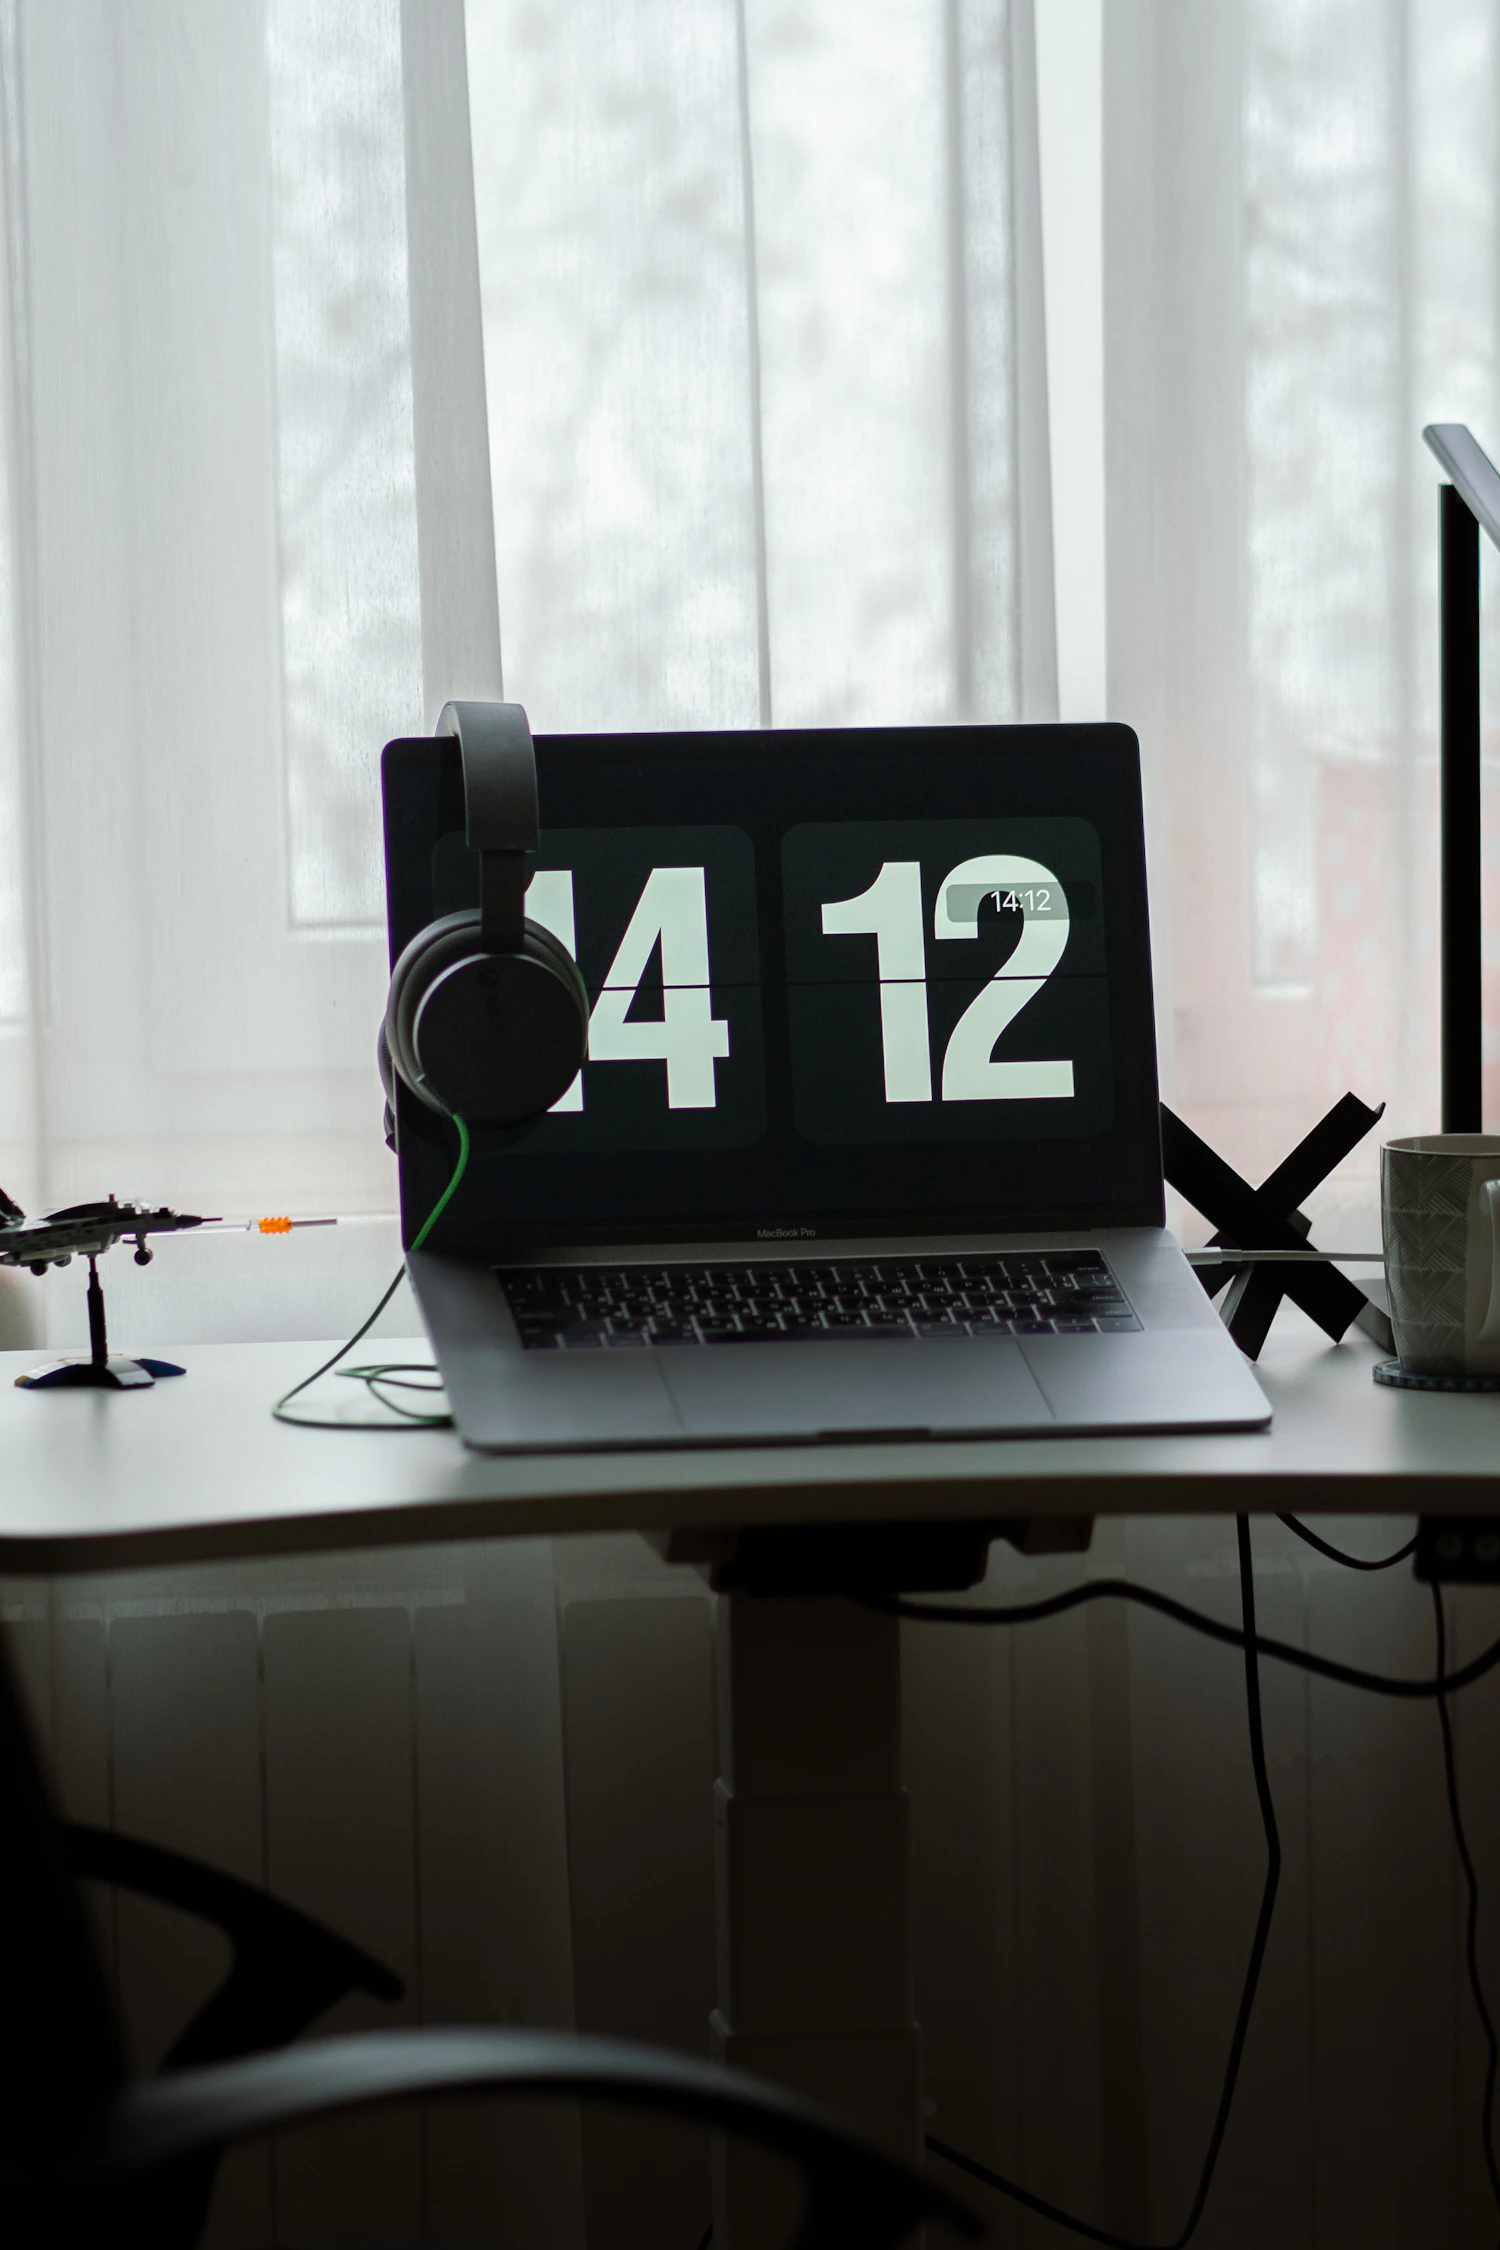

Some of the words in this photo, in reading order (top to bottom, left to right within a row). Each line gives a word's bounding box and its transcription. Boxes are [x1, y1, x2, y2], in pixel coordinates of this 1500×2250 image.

[990, 888, 1052, 913] 14:12
[820, 854, 1075, 1103] 12
[756, 1228, 799, 1239] MacBook
[800, 1227, 817, 1237] Pro
